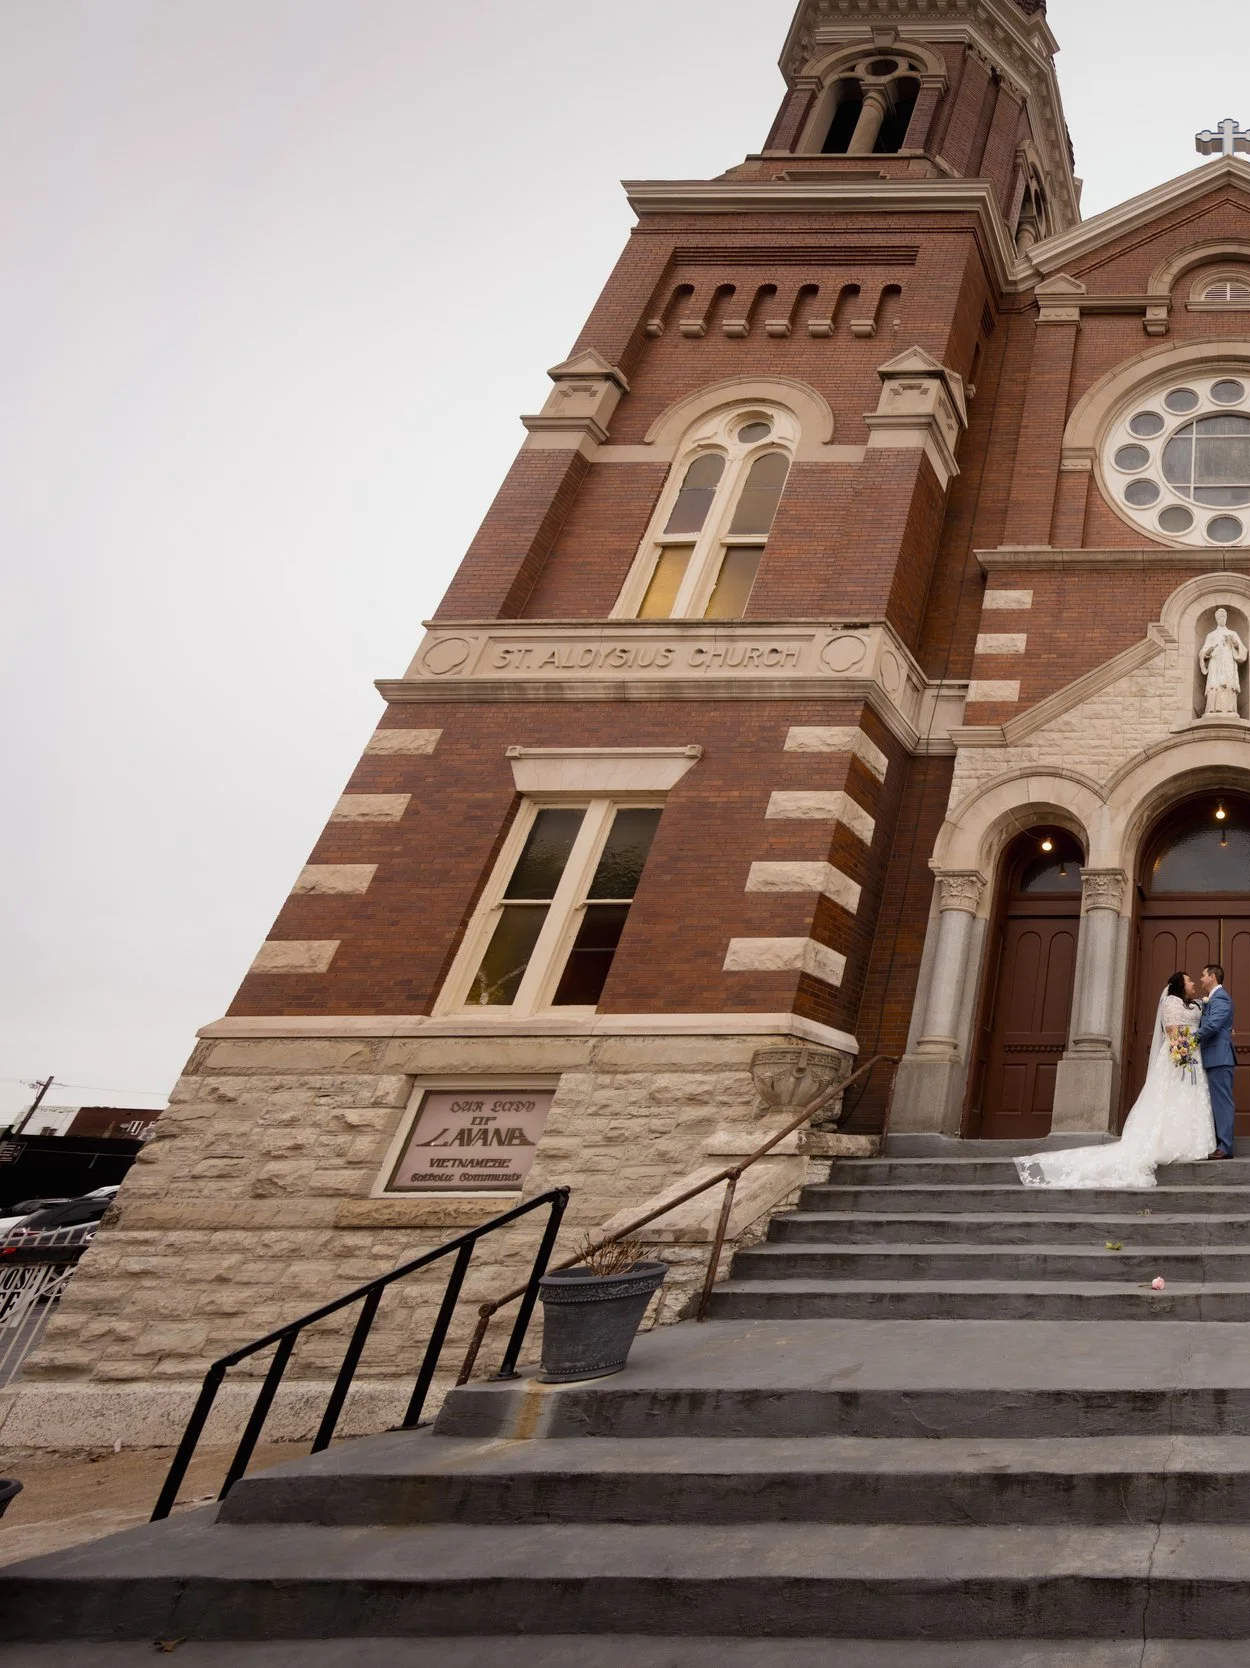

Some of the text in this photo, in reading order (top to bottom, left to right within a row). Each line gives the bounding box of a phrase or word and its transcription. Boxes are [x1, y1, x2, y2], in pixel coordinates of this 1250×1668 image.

[493, 646, 801, 669] ST. ALOYSIUS CHURCH
[450, 1101, 485, 1113] OUR
[470, 1116, 498, 1126] OF
[429, 1157, 513, 1168] VIETNAMESE
[410, 1172, 522, 1182] Catholic Community
